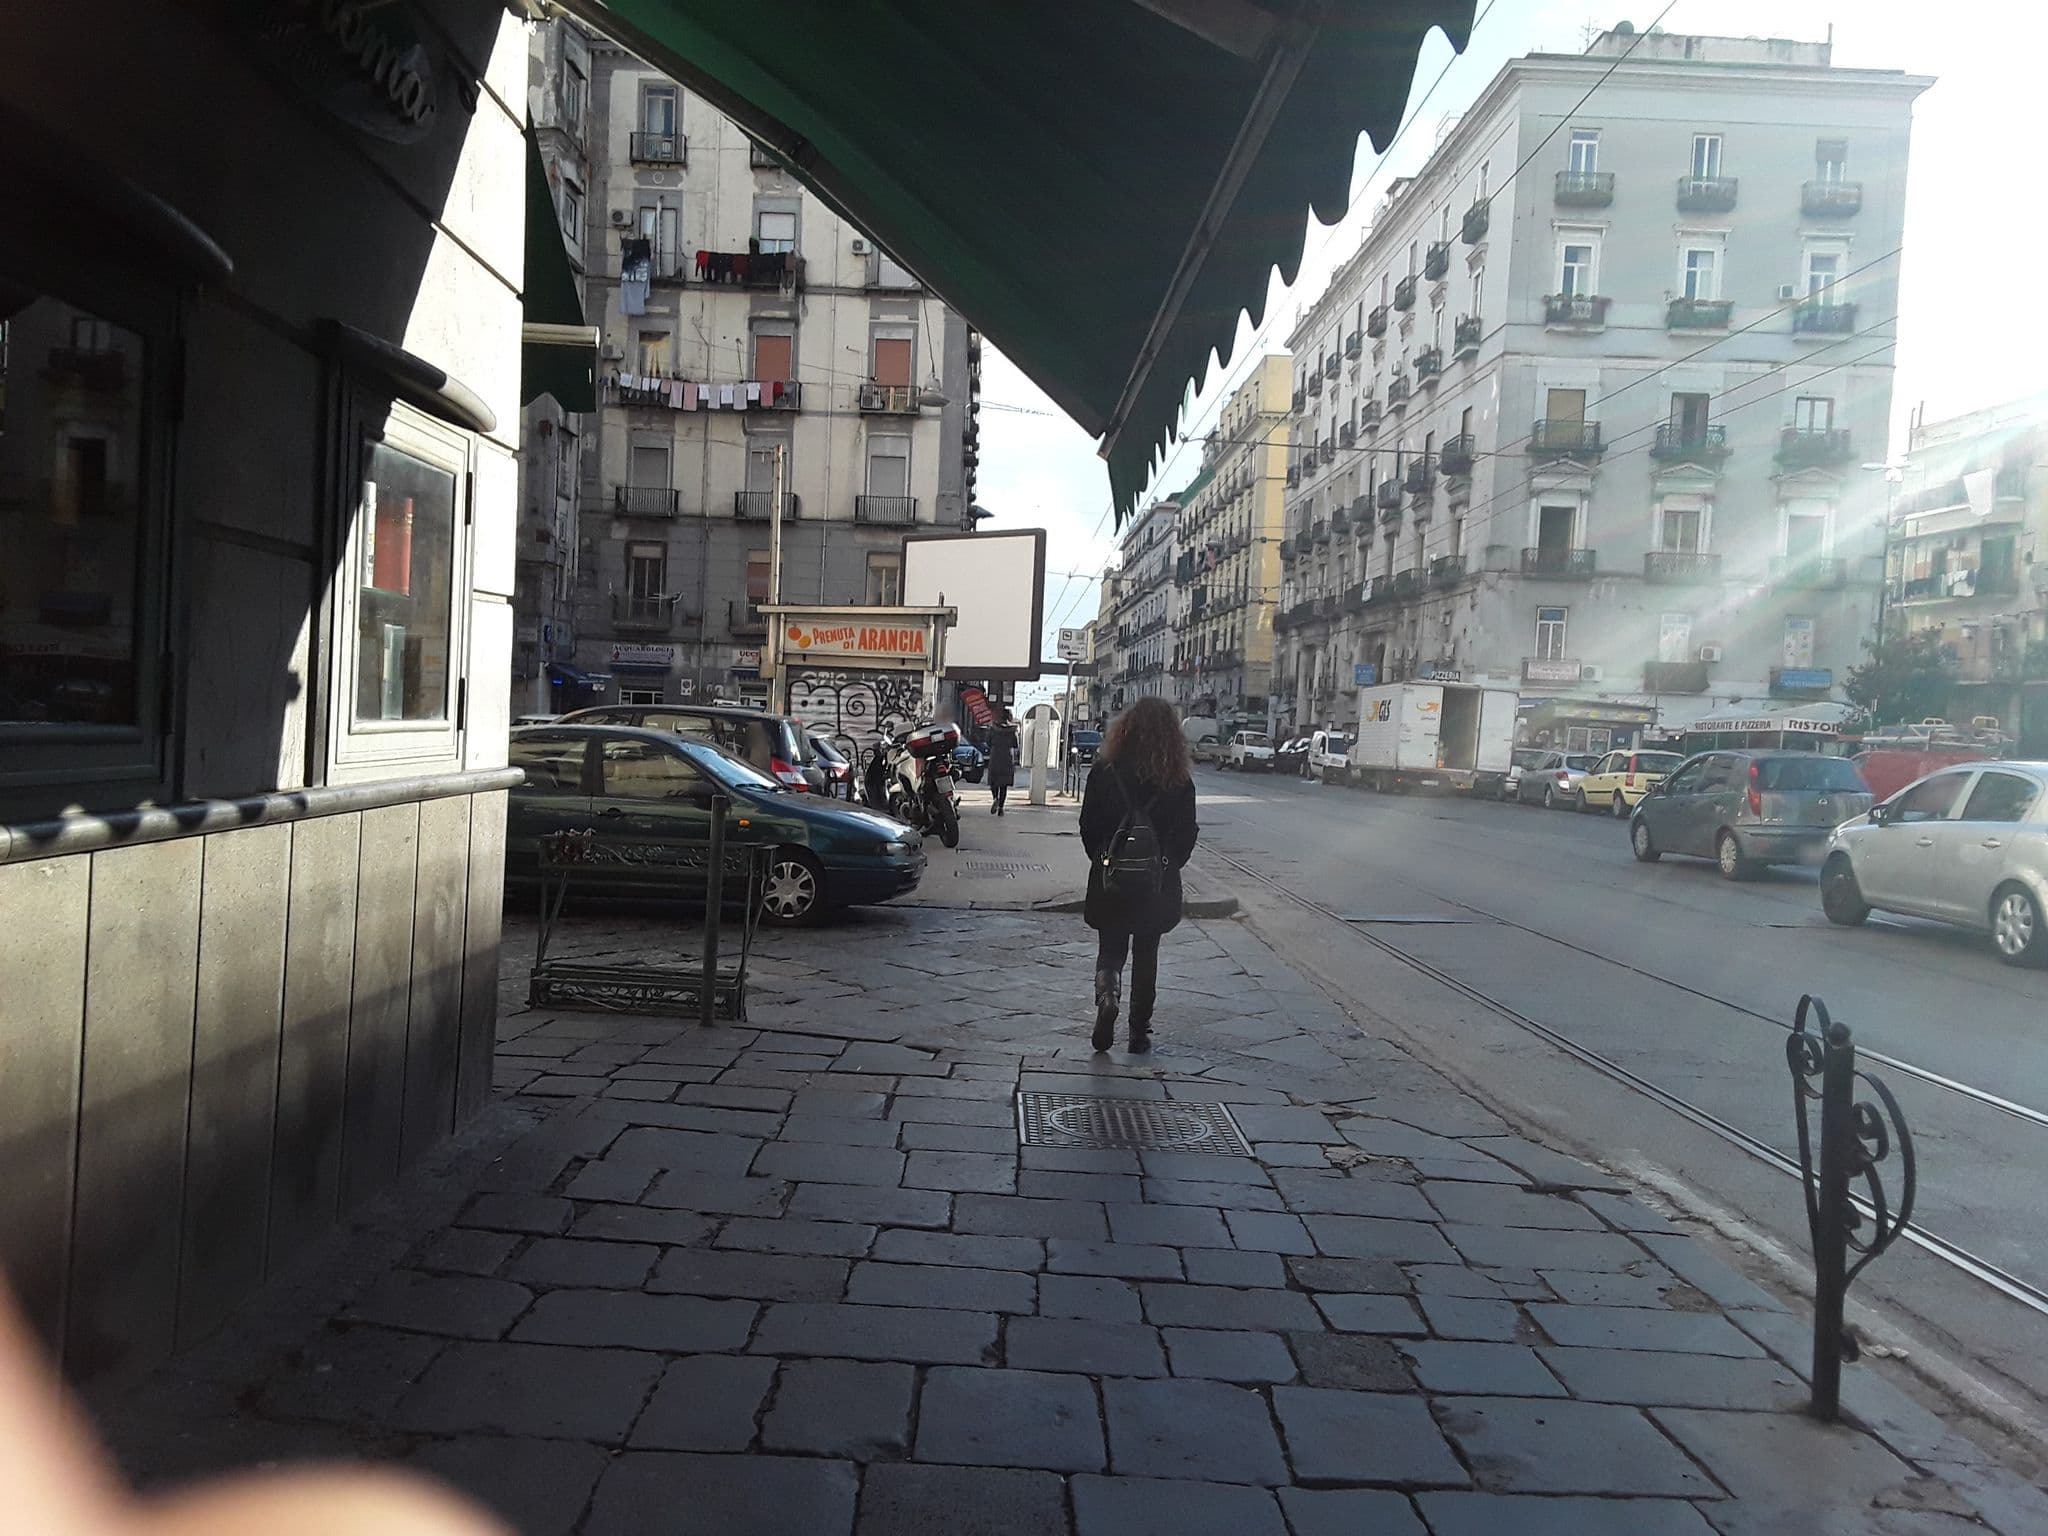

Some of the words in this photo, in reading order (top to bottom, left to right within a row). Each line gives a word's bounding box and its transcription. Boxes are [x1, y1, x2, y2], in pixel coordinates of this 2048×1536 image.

[858, 627, 923, 652] ARANCIA
[1431, 671, 1459, 681] PIZZERIA
[1379, 699, 1392, 722] GLS
